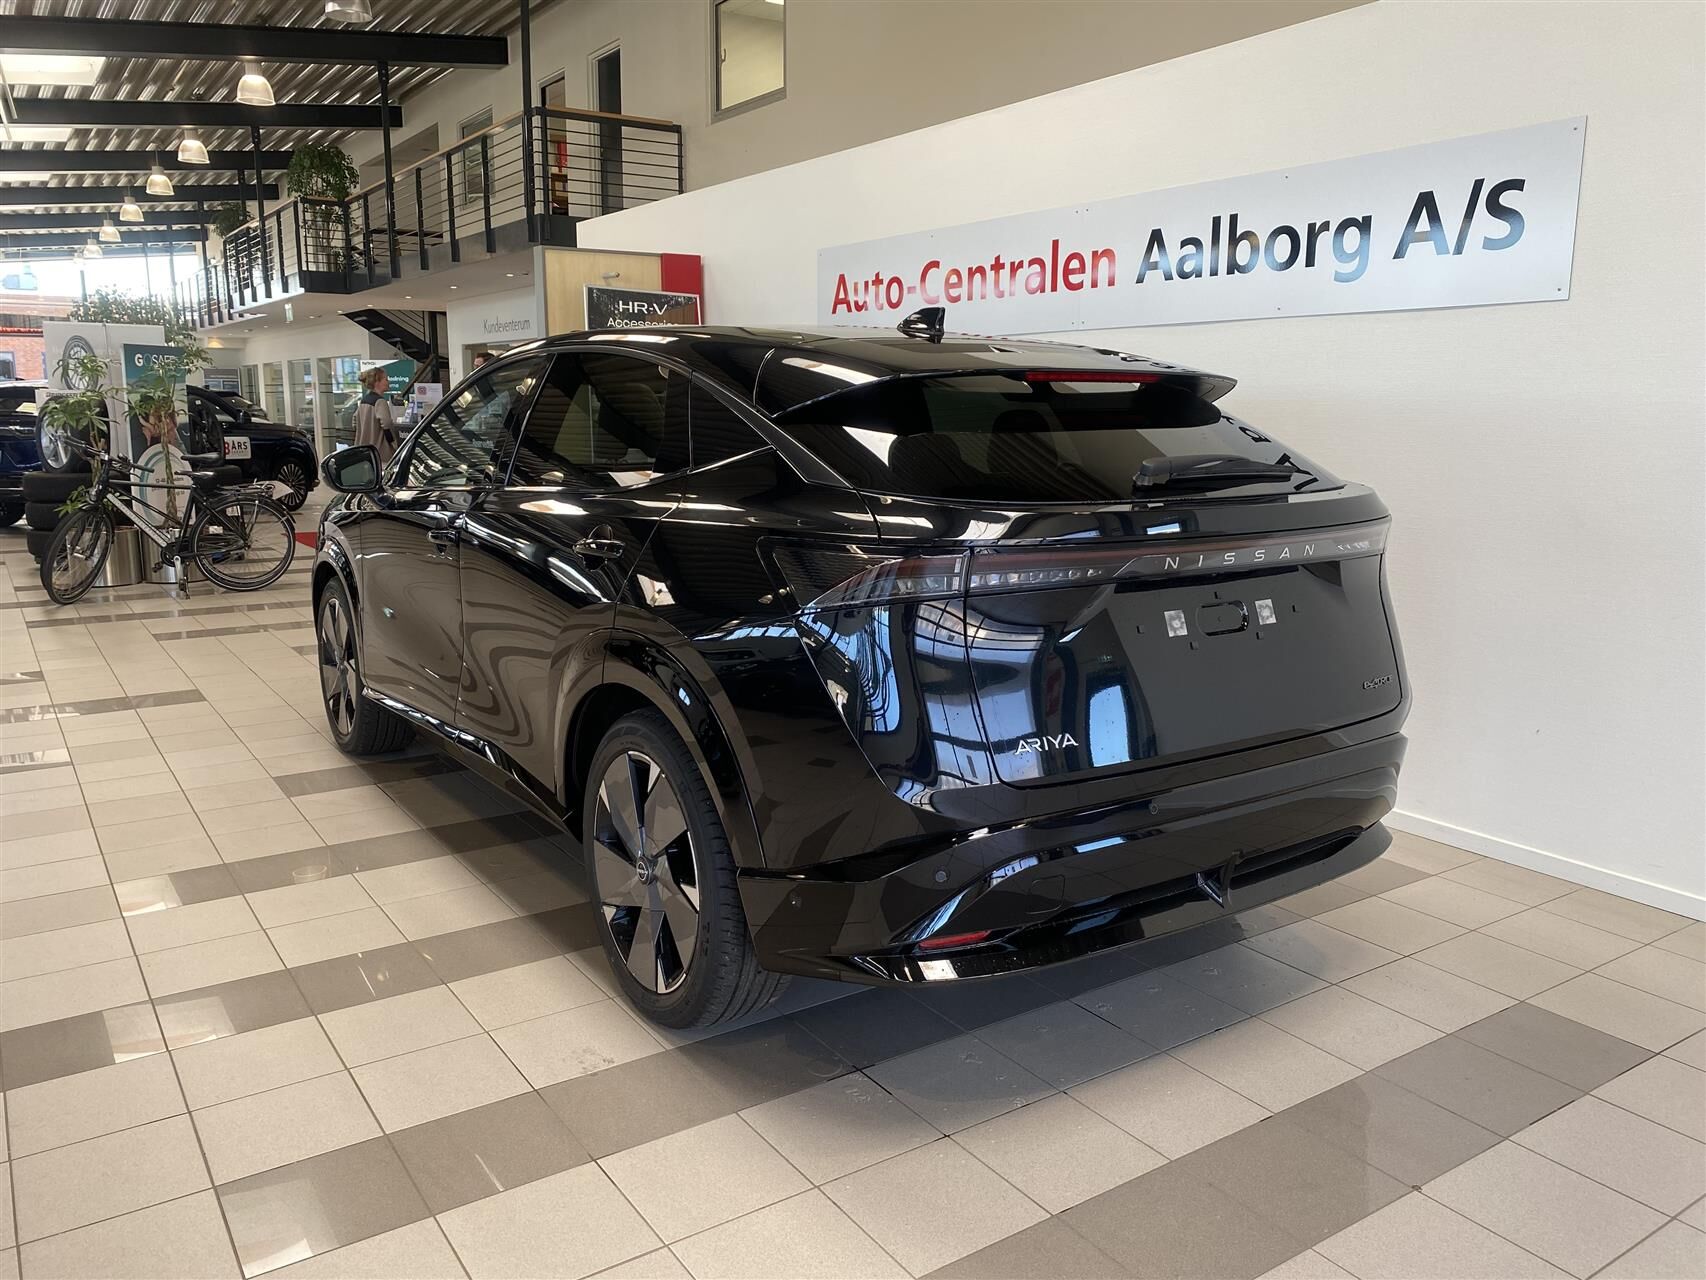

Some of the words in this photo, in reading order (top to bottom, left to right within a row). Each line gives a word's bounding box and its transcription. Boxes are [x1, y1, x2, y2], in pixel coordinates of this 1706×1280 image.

[832, 239, 1117, 315] Auto-Centralen
[1135, 212, 1372, 284] Aalborg
[1393, 177, 1525, 260] A/S
[618, 300, 668, 316] HR-V
[1164, 543, 1315, 570] NISSAN
[1014, 732, 1079, 756] ARIYA
